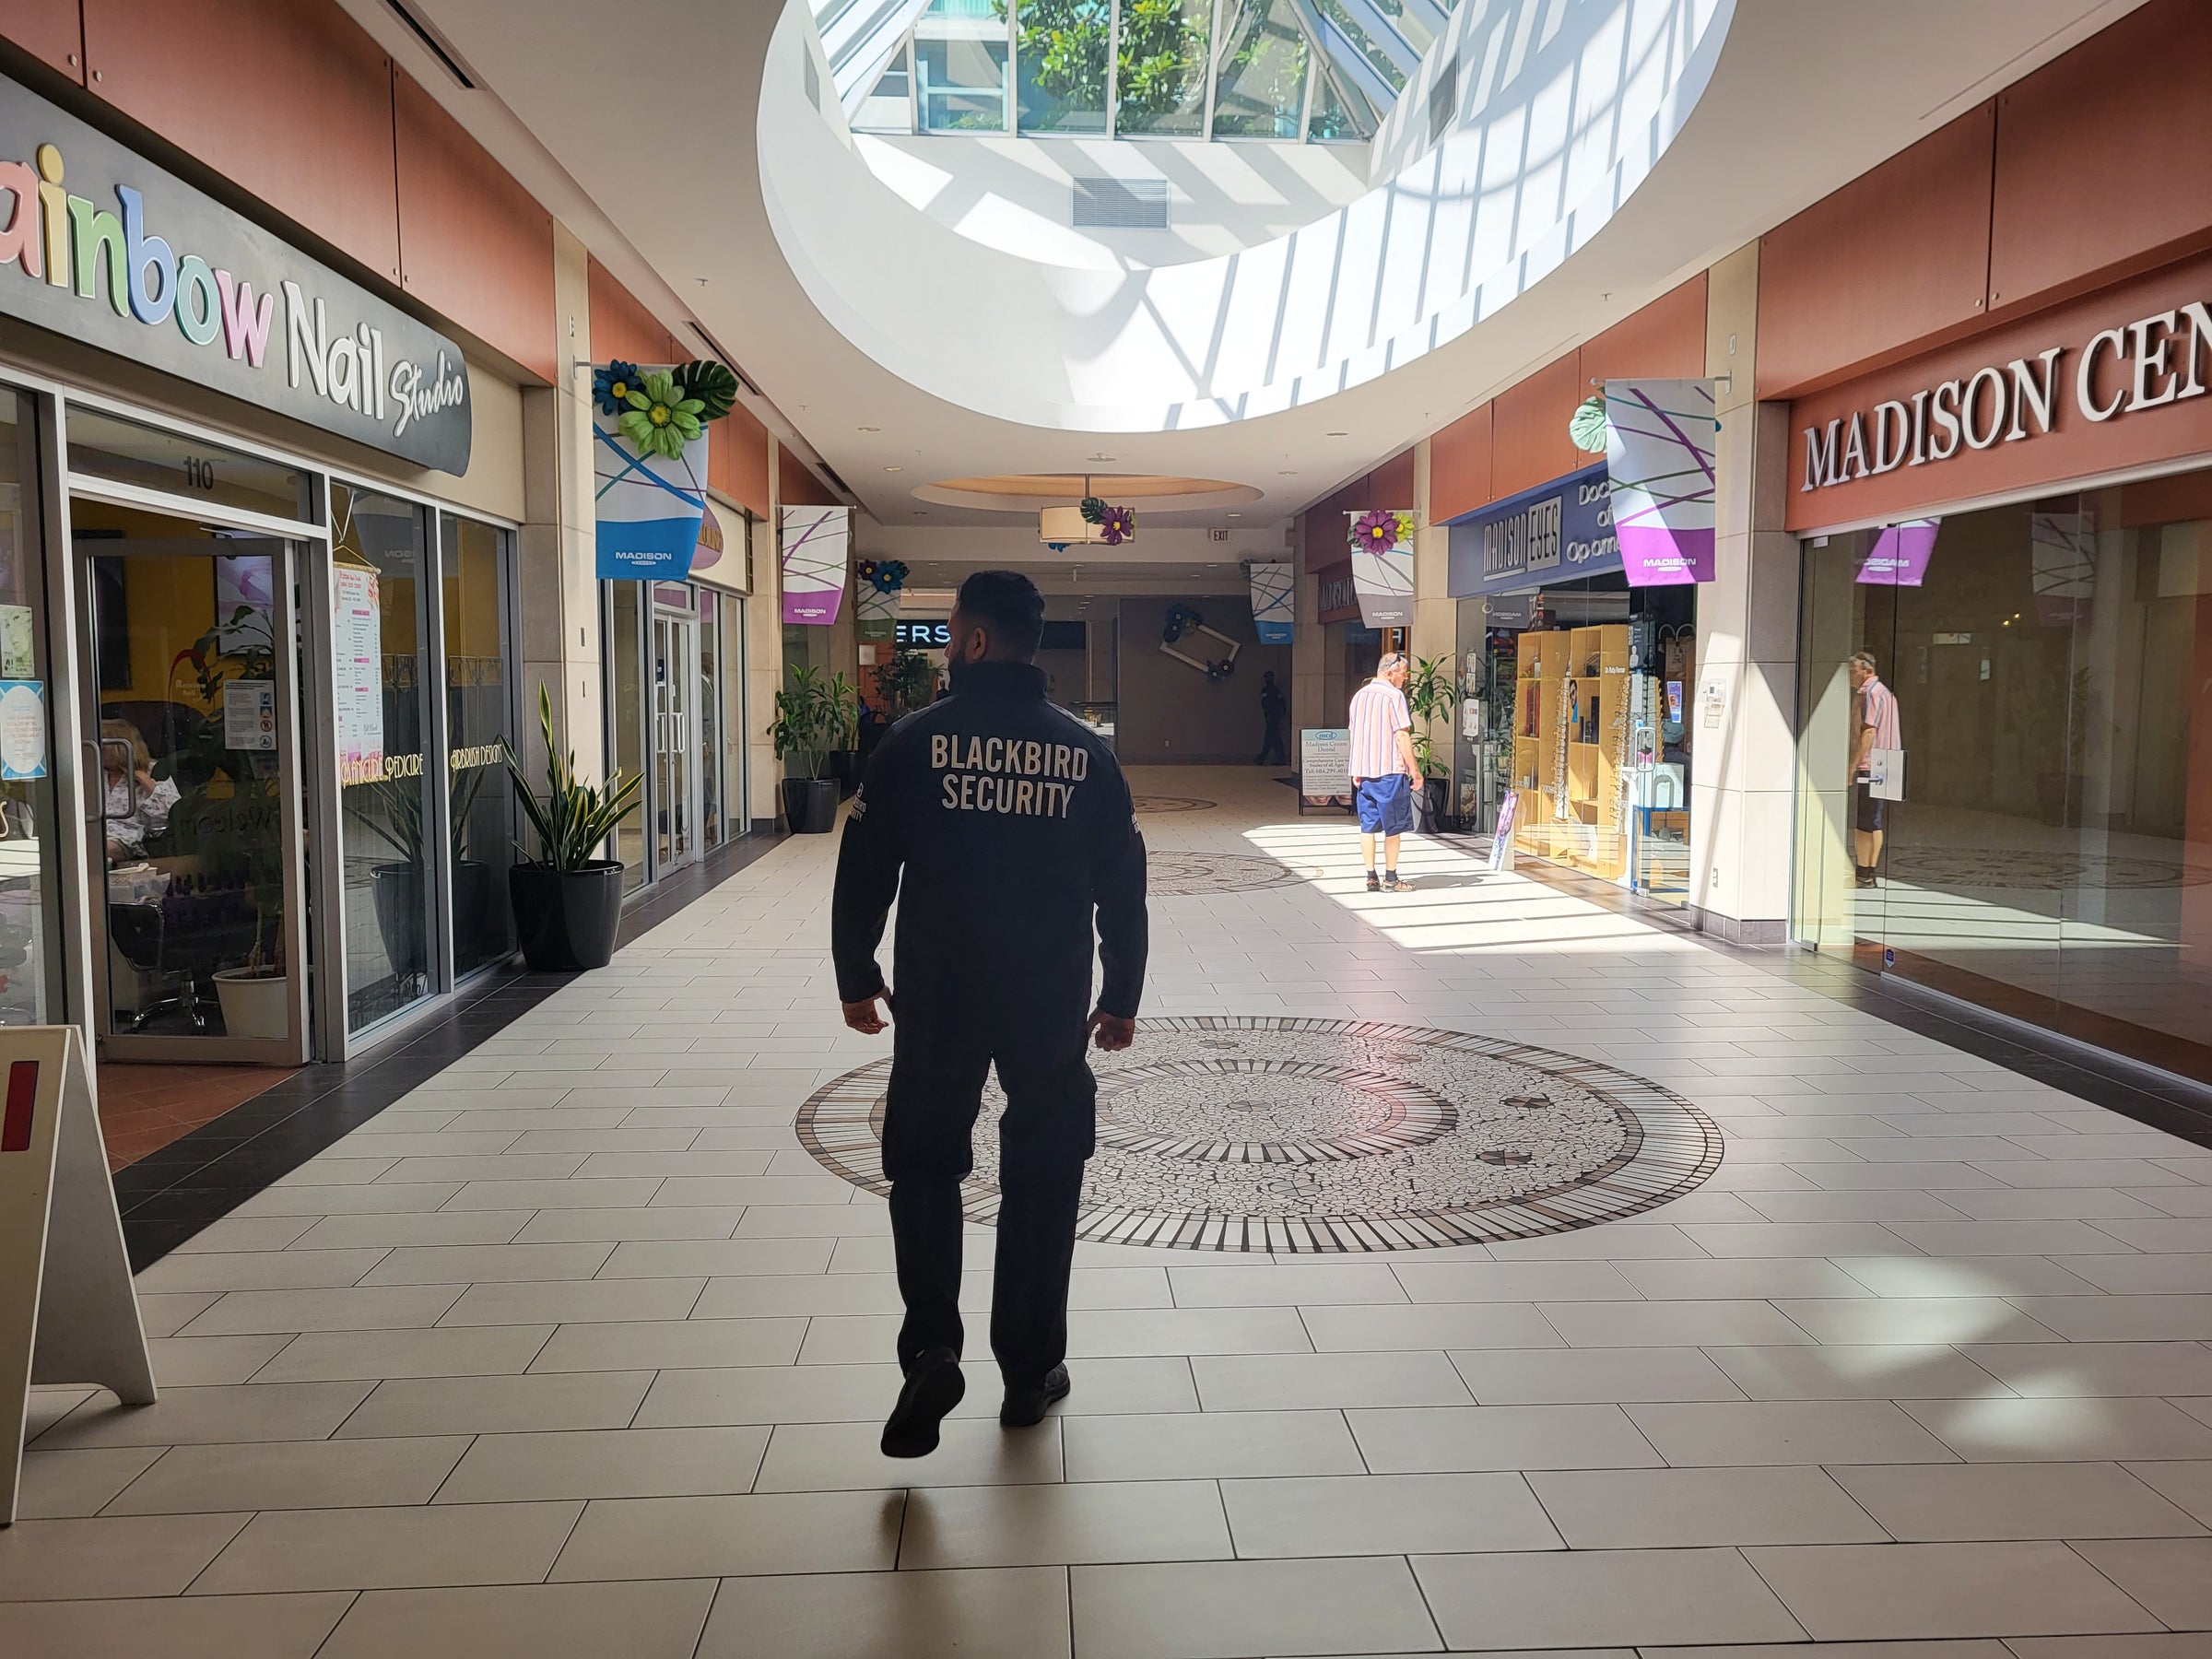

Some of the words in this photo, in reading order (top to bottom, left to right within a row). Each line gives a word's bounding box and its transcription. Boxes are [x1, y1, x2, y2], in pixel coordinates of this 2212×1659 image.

[281, 280, 384, 420] Nail
[388, 349, 465, 438] Studio
[1801, 347, 2064, 492] MADISON
[183, 455, 215, 491] 110
[1214, 530, 1229, 541] EXIT
[1483, 512, 1526, 573] MADISON
[1530, 503, 1559, 562] EYES
[615, 551, 672, 560] MADISON
[1642, 558, 1697, 567] MADISON
[384, 753, 424, 782] PEDICURE
[450, 747, 480, 772] AIRBRUSH
[931, 734, 1088, 782] BLACKBIRD
[941, 773, 1076, 819] SECURITY
